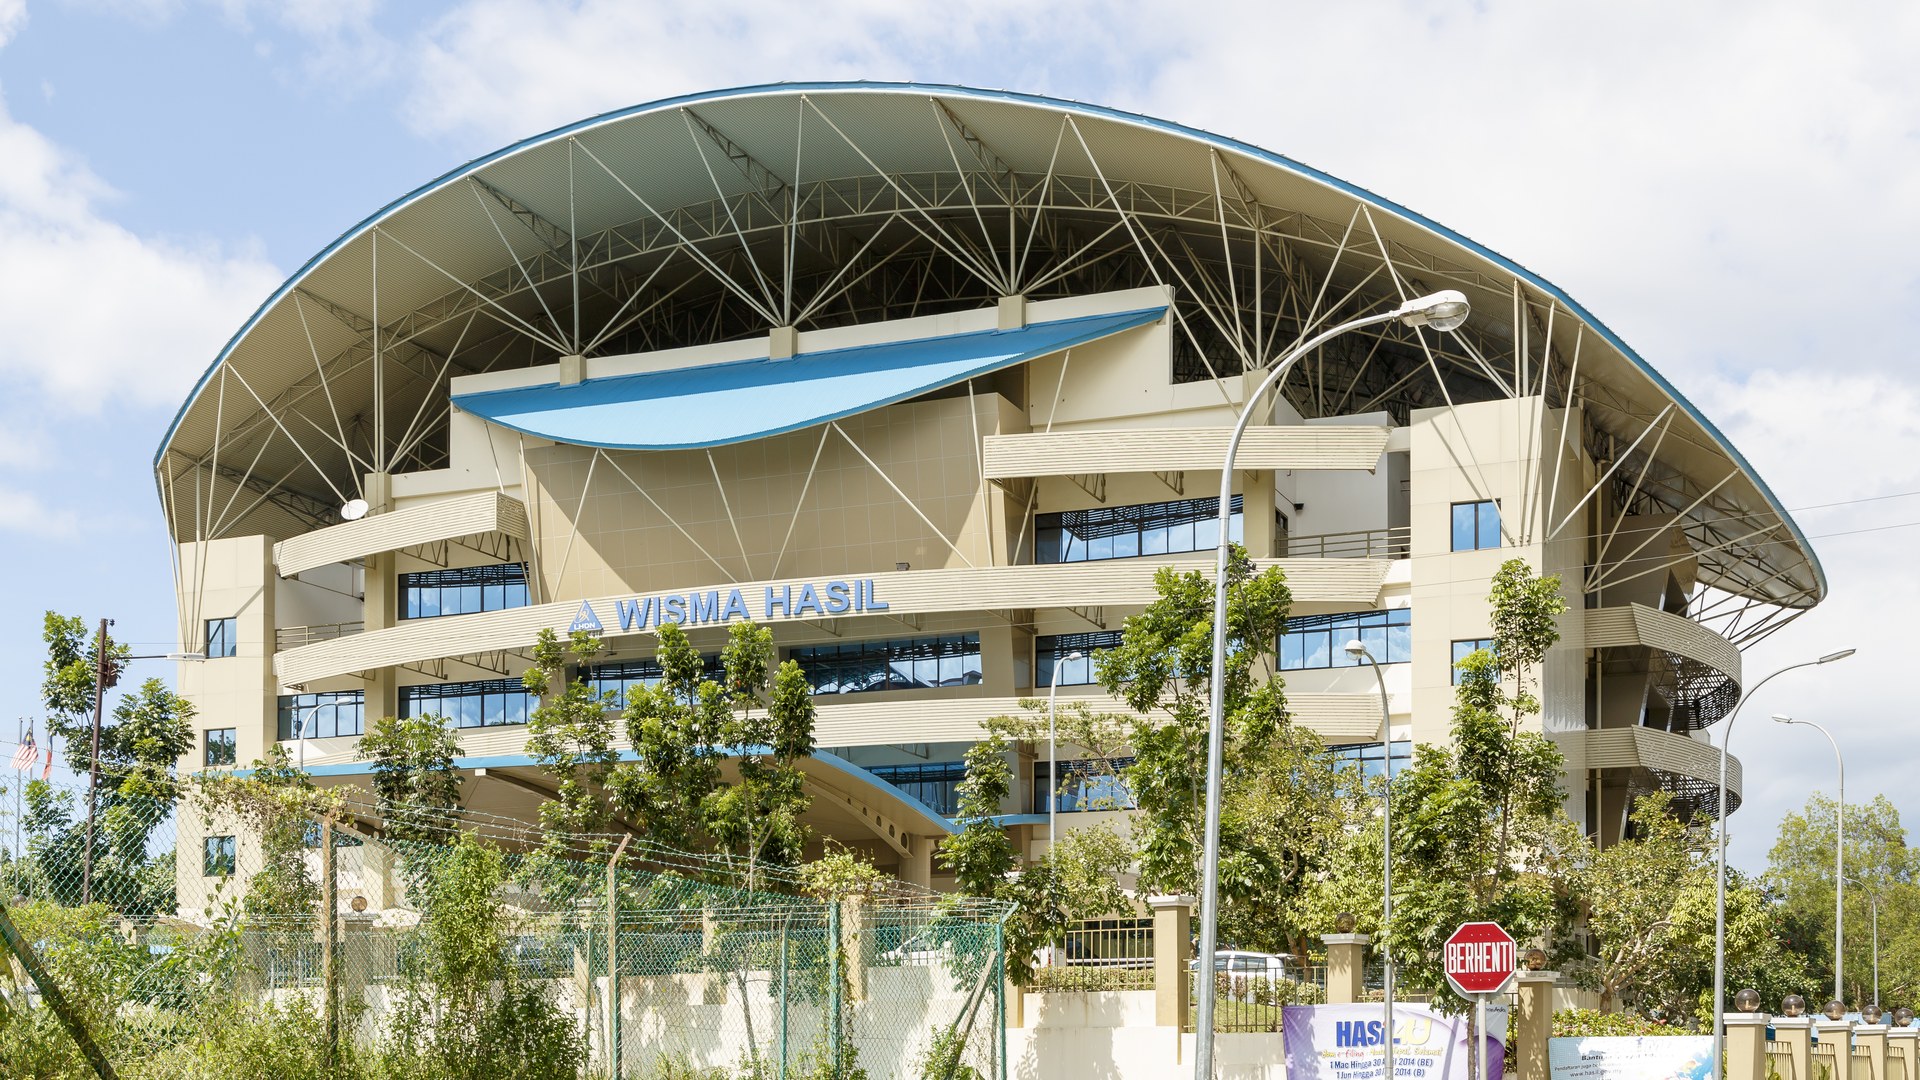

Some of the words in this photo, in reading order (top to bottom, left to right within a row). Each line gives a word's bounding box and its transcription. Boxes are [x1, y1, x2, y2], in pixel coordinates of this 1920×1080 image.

[615, 589, 750, 630] WISMA
[765, 579, 889, 616] HASIL
[574, 622, 596, 630] LHDN
[1448, 942, 1512, 973] BERHENTI
[1334, 1061, 1349, 1069] Mac
[1351, 1060, 1372, 1070] Hingga
[1373, 1058, 1382, 1066] 30
[1417, 1058, 1433, 1067] (BE)
[1341, 1071, 1352, 1079] Jun
[1353, 1070, 1374, 1079] Hingga
[1375, 1068, 1382, 1076] 30
[1394, 1068, 1411, 1076] 2014
[1413, 1069, 1425, 1077] (B)
